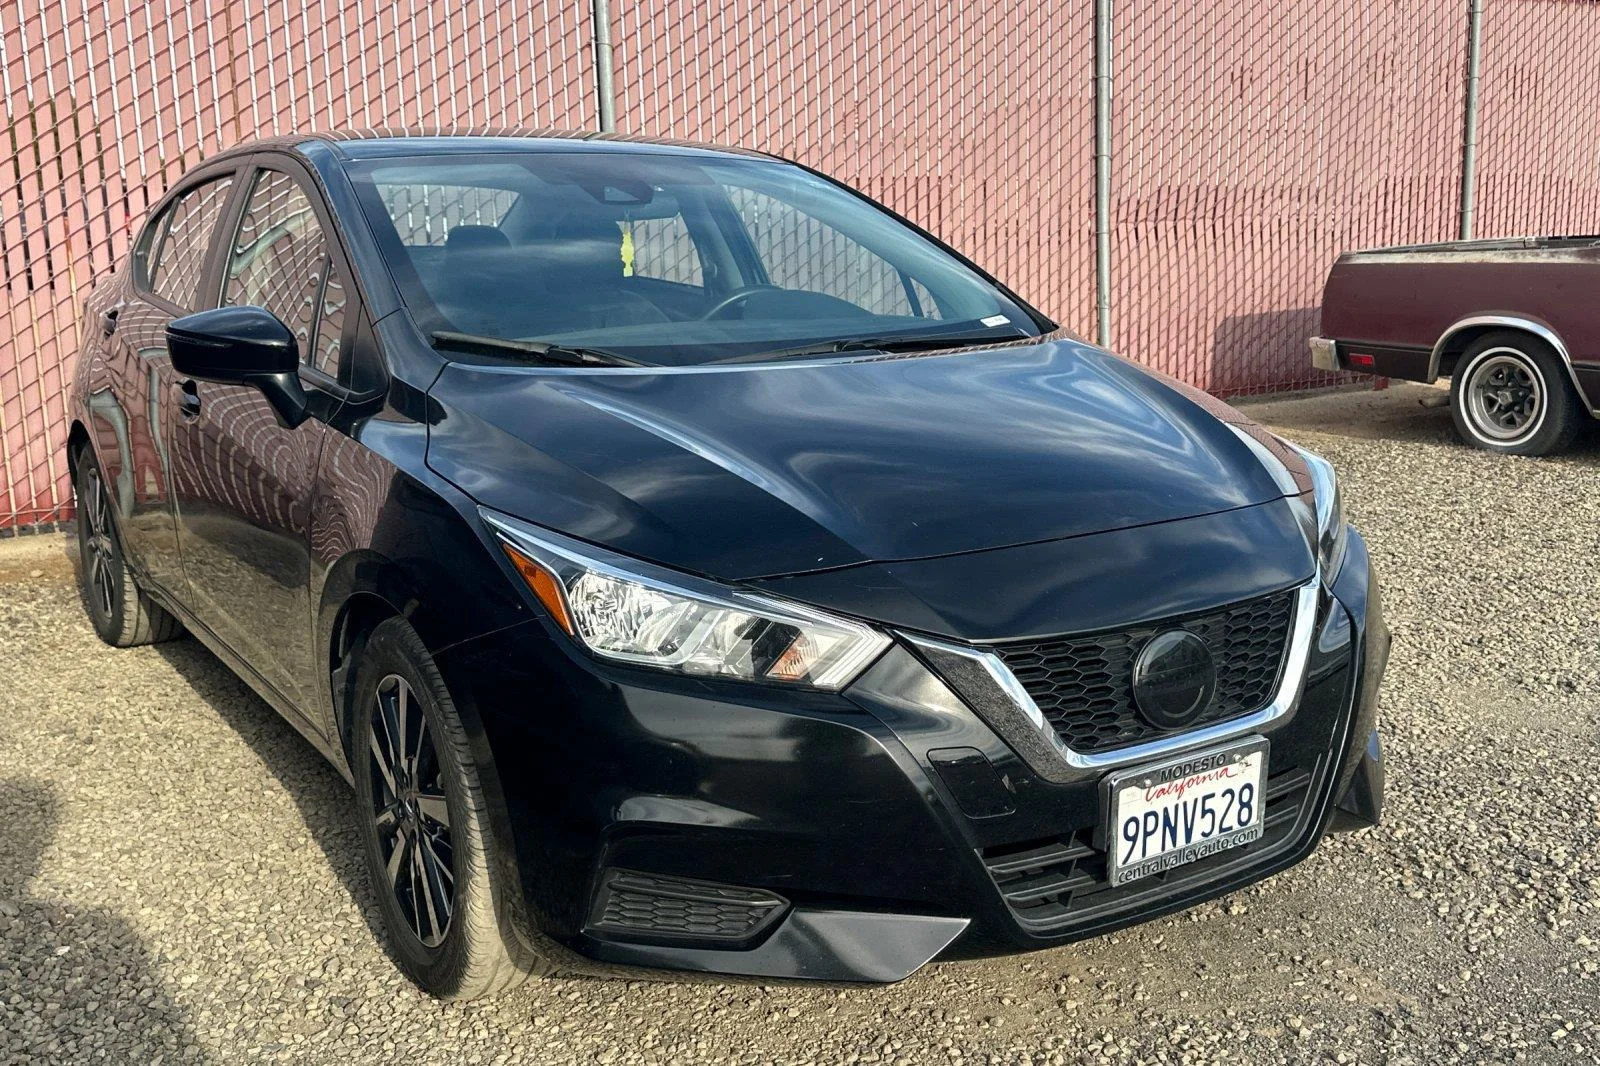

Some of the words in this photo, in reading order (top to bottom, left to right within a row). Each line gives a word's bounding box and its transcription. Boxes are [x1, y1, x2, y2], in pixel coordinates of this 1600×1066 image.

[1144, 765, 1238, 802] California
[1160, 753, 1226, 782] MODESTO
[1121, 782, 1254, 865] 9PNV528
[1118, 827, 1258, 884] centralvalleyauto.com
